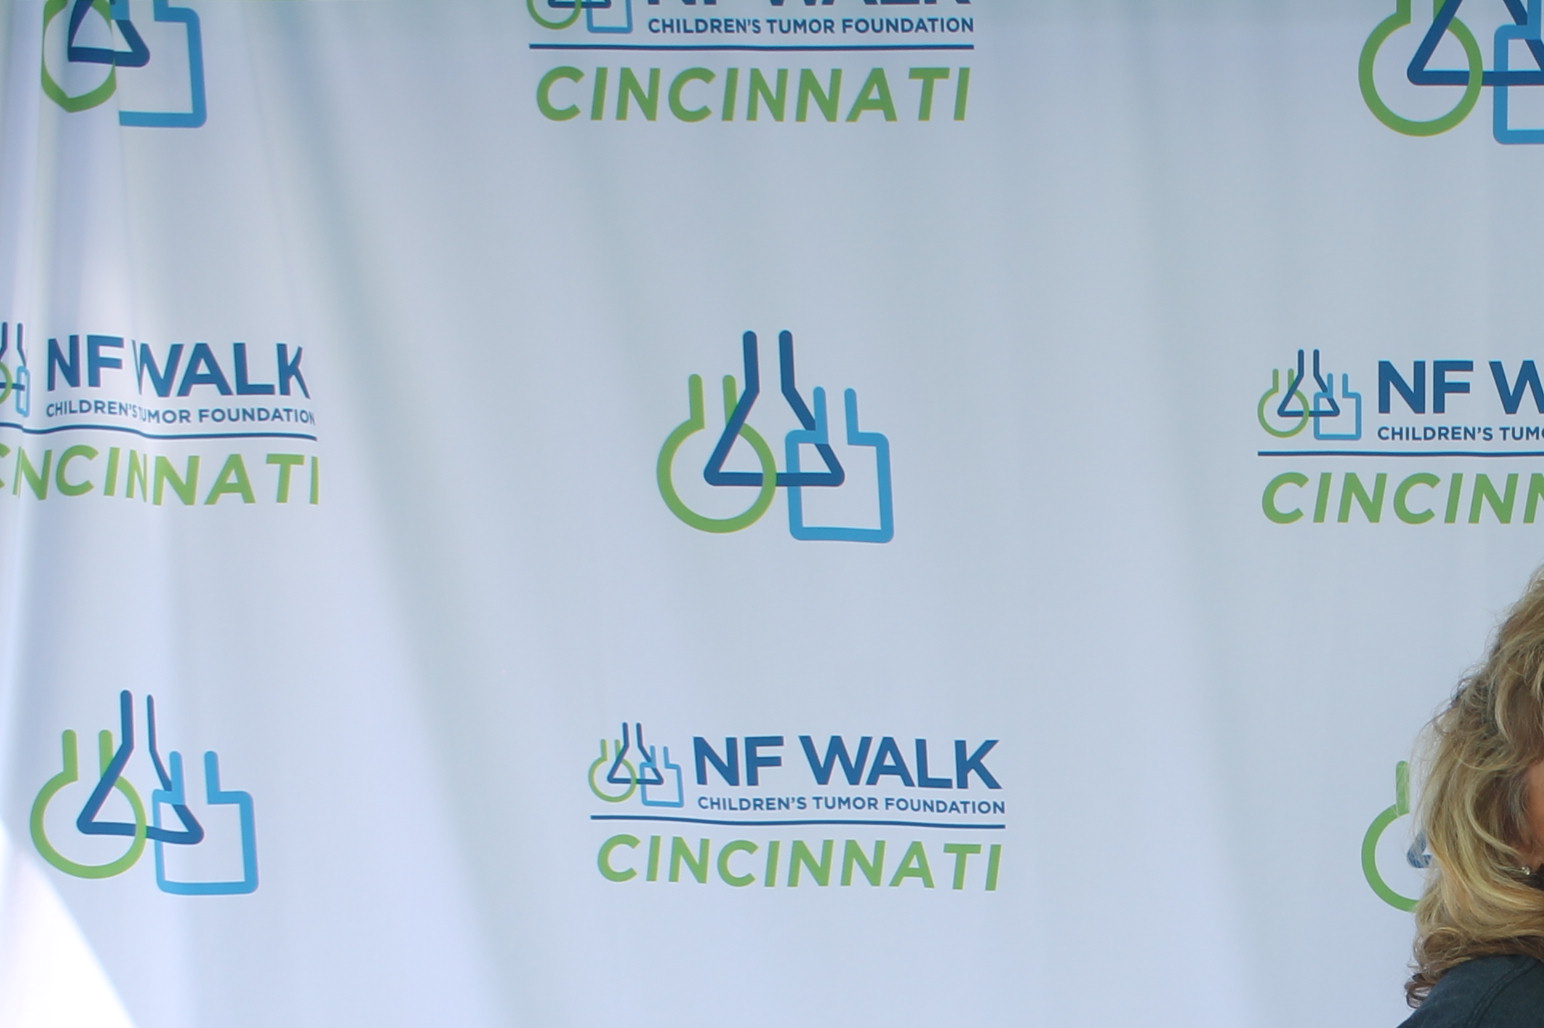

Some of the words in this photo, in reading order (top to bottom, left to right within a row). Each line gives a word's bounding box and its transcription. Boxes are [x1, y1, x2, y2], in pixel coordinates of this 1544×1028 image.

[769, 18, 835, 35] TUMOR
[842, 17, 974, 34] FOUNDATION
[536, 65, 971, 122] CINCINNATI
[47, 335, 124, 391] NF
[132, 342, 310, 399] WALK
[1378, 360, 1474, 414] NF
[199, 408, 316, 426] FOUNDATION
[0, 444, 319, 506] NCINNATI
[693, 736, 784, 786] NF
[799, 735, 1002, 790] WALK
[815, 796, 878, 811] TUMOR
[885, 798, 1006, 815] FOUNDATION
[597, 834, 1001, 891] CINCINNATI
